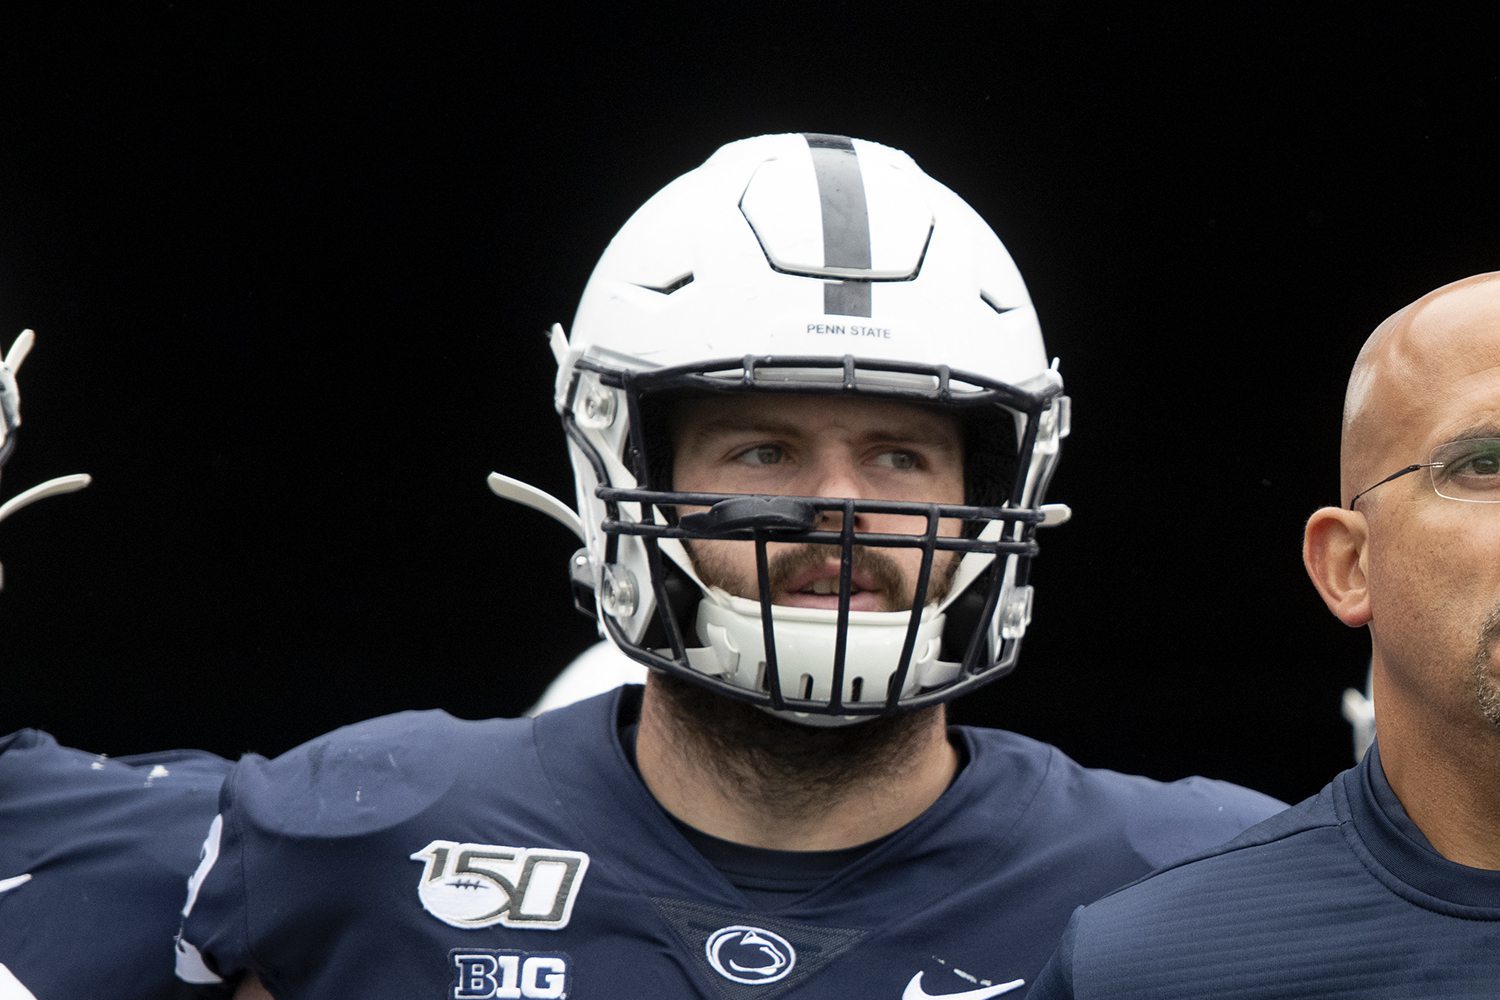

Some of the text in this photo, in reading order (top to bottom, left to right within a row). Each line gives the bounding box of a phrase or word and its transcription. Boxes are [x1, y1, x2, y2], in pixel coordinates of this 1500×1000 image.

[806, 323, 892, 340] PENN STATE
[420, 843, 585, 925] 150
